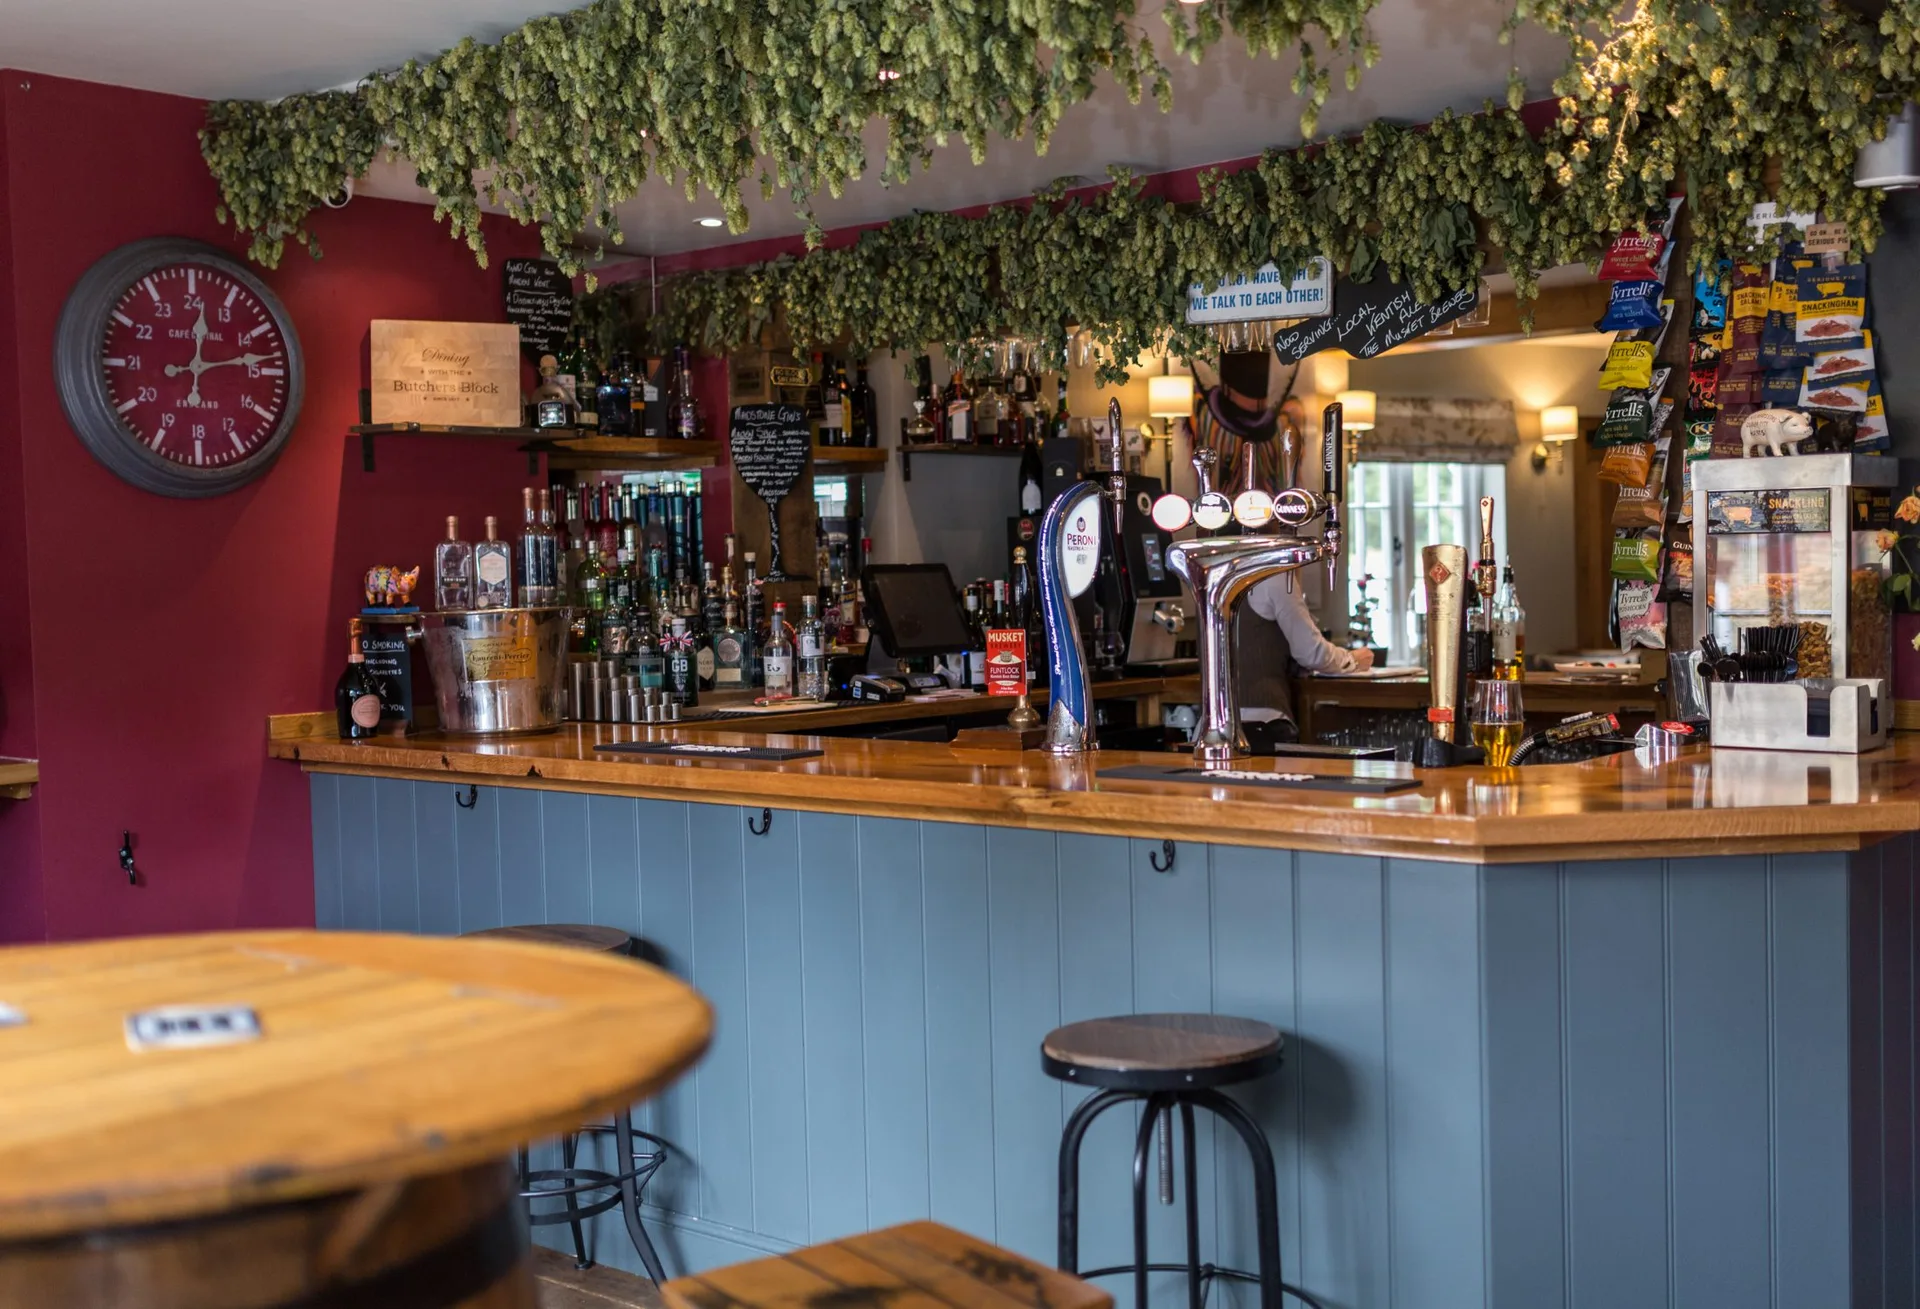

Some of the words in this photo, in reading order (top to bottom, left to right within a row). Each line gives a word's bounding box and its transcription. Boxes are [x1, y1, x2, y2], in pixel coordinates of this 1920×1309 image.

[1808, 238, 1835, 246] SERIOUS
[1837, 236, 1848, 244] PIG
[1253, 271, 1279, 285] HAVE
[184, 295, 201, 310] 24
[1192, 297, 1208, 311] WE
[1212, 295, 1236, 309] TALK
[1239, 293, 1252, 307] TO
[1256, 291, 1282, 306] EACH
[1286, 288, 1323, 304] OTHER!
[1736, 292, 1766, 301] SNACKING
[155, 303, 172, 318] 23
[1365, 290, 1412, 336] KENTISH
[1802, 300, 1859, 312] SNACKINGHAM
[218, 308, 231, 323] 13
[1337, 302, 1377, 342] LOCAL
[136, 325, 153, 340] 22
[1359, 336, 1380, 358] THE
[1385, 314, 1424, 348] MUSKET
[238, 333, 252, 347] 14
[1276, 331, 1300, 352] NOW
[128, 355, 140, 370] 21
[421, 348, 470, 368] Dining
[248, 364, 260, 378] 15
[138, 387, 157, 402] 20
[461, 381, 499, 394] Block
[176, 399, 219, 410] ENAND
[241, 394, 254, 409] 16
[162, 413, 175, 428] 19
[1603, 402, 1644, 426] yrrell's
[192, 424, 205, 438] 18
[223, 418, 235, 431] 17
[1323, 432, 1334, 472] GUINNESS
[1276, 503, 1308, 515] GUINNESS
[1769, 496, 1825, 509] SNACKLING
[1067, 533, 1096, 546] PERONI
[1672, 541, 1693, 551] GUIN
[988, 632, 1024, 643] MUSKET
[371, 640, 405, 651] SMOKING
[472, 652, 531, 662] Laurent-Perrier
[671, 659, 688, 672] GB
[990, 667, 1020, 675] FLINTLOCK
[389, 704, 406, 713] YOU
